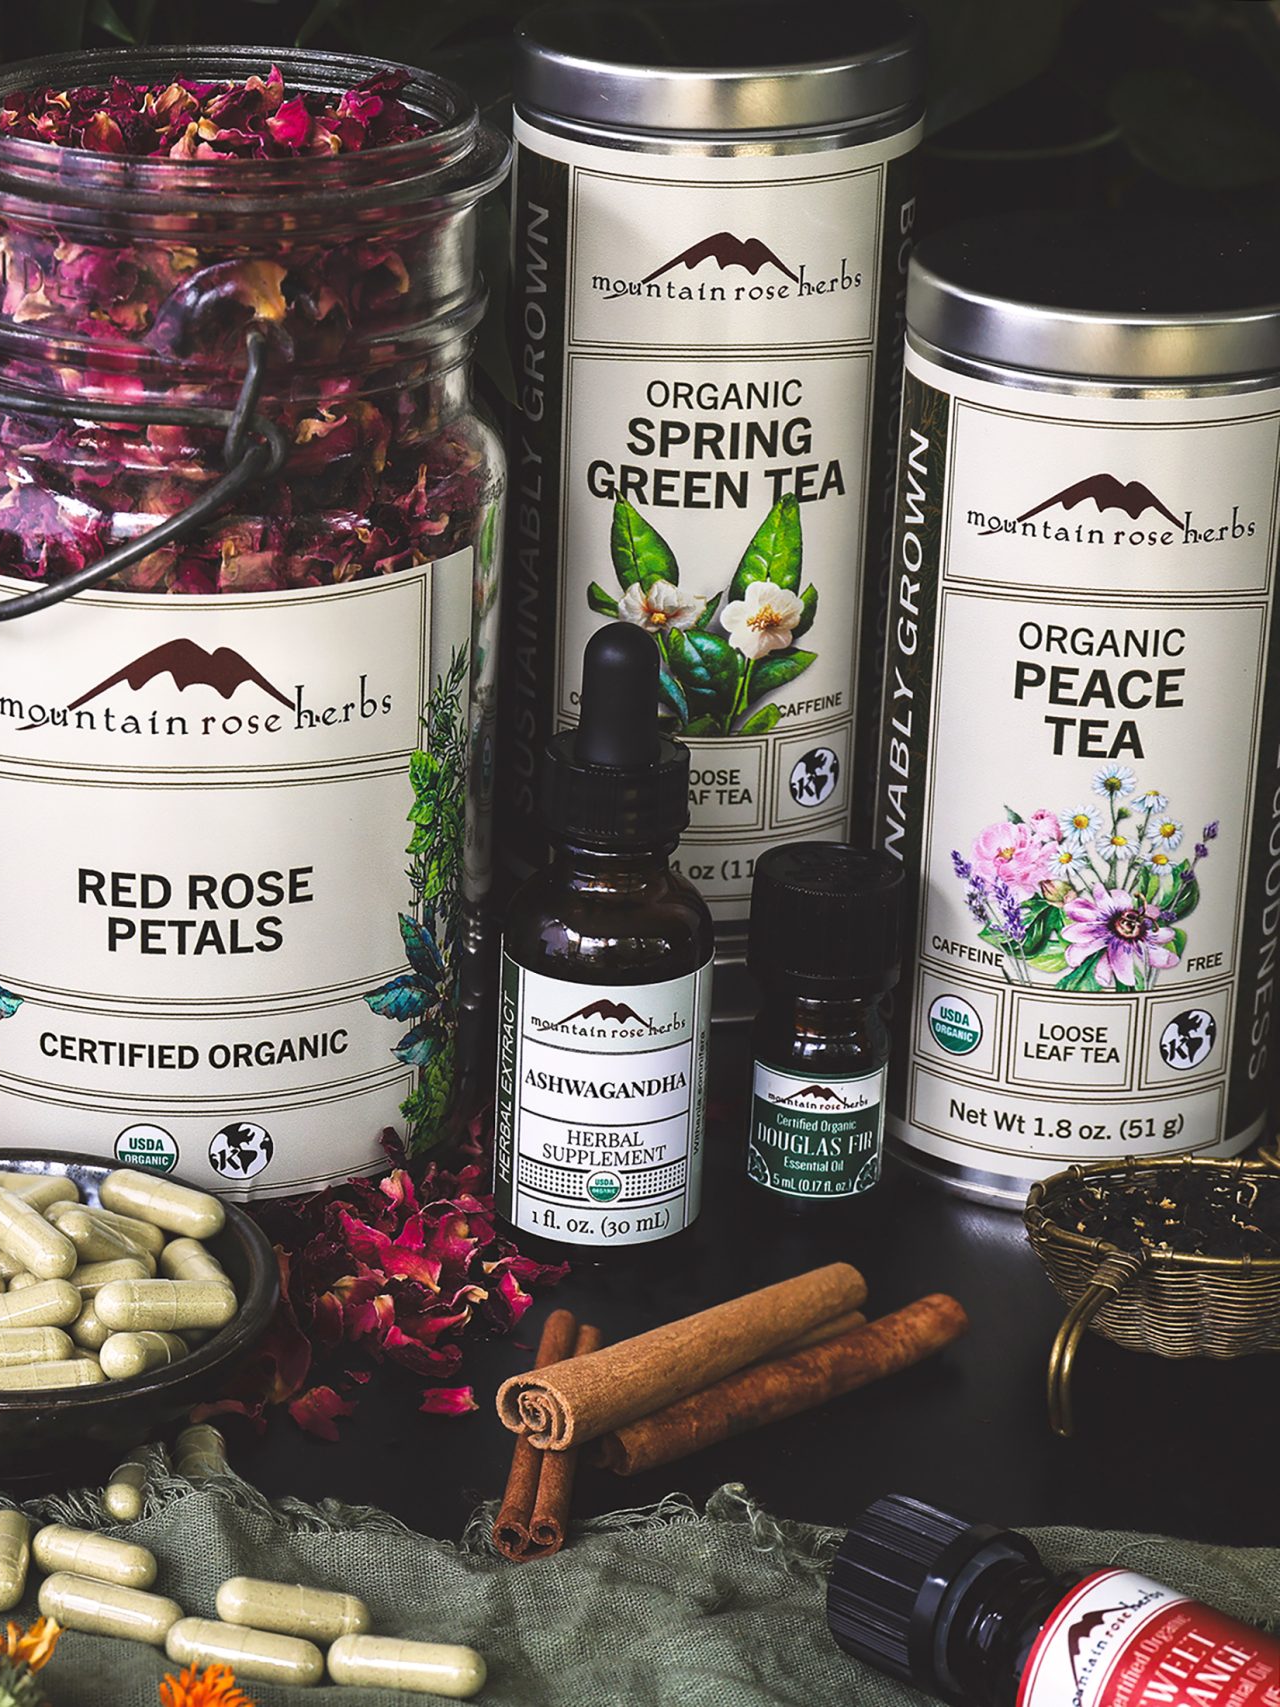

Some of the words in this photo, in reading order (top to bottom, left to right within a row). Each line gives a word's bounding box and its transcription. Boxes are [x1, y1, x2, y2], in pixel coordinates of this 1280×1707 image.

[592, 273, 726, 301] mountain
[735, 283, 789, 301] rose
[798, 259, 862, 297] herbs
[523, 201, 550, 422] GROWN
[646, 379, 803, 410] ORGANIC
[627, 417, 812, 461] SPRING
[586, 459, 749, 510] GREEN
[764, 459, 846, 501] TEA
[897, 428, 930, 656] GROWN
[966, 509, 1106, 545] mountain
[1114, 528, 1174, 546] rose
[1182, 507, 1256, 545] herbs
[1018, 621, 1186, 658] ORGANIC
[1013, 660, 1186, 709] PEACE
[201, 714, 282, 736] rose
[294, 675, 393, 730] herbs
[778, 692, 843, 718] CAFFEINE
[1044, 715, 1145, 759] TEA
[689, 770, 740, 785] OOSE
[716, 789, 752, 805] TEA
[77, 867, 172, 911] RED
[188, 865, 314, 911] ROSE
[106, 915, 284, 956] PETALS
[931, 935, 1005, 968] CAFFEINE
[1186, 952, 1223, 973] FREE
[531, 1015, 607, 1038] mountain
[611, 1021, 644, 1038] rose
[648, 1012, 686, 1037] herbs
[934, 1021, 974, 1043] ORGANIC
[940, 1006, 970, 1027] USDA
[1038, 1023, 1108, 1044] LOOSE
[39, 1031, 199, 1070] CERTIFIED
[208, 1028, 349, 1070] ORGANIC
[502, 990, 516, 1096] EXTRACT
[1024, 1042, 1074, 1063] LEAF
[1080, 1046, 1121, 1064] TEA
[525, 1069, 688, 1100] ASHWAGANDHA
[567, 1129, 644, 1148] HERBAL
[776, 1113, 818, 1131] Certified
[949, 1099, 987, 1128] Net
[994, 1110, 1026, 1134] Wt
[1033, 1118, 1072, 1139] 1.8
[1078, 1123, 1112, 1141] oz.
[1119, 1119, 1156, 1141] (51
[1163, 1113, 1185, 1138] g)
[128, 1136, 165, 1152] USDA
[499, 1097, 514, 1184] HERBAL
[542, 1143, 667, 1167] SUPPLEMENT
[757, 1122, 842, 1156] DOUGLAS
[848, 1131, 873, 1154] FIR
[124, 1154, 169, 1167] ORGANIC
[784, 1156, 828, 1172] Essential
[831, 1160, 844, 1172] Oil
[532, 1209, 538, 1224] 1
[543, 1209, 561, 1230] fl.
[567, 1219, 594, 1234] oz.
[601, 1217, 630, 1239] (30
[636, 1209, 670, 1231] mL)
[1139, 1628, 1216, 1707] WEET
[1176, 1641, 1259, 1707] ANGE
